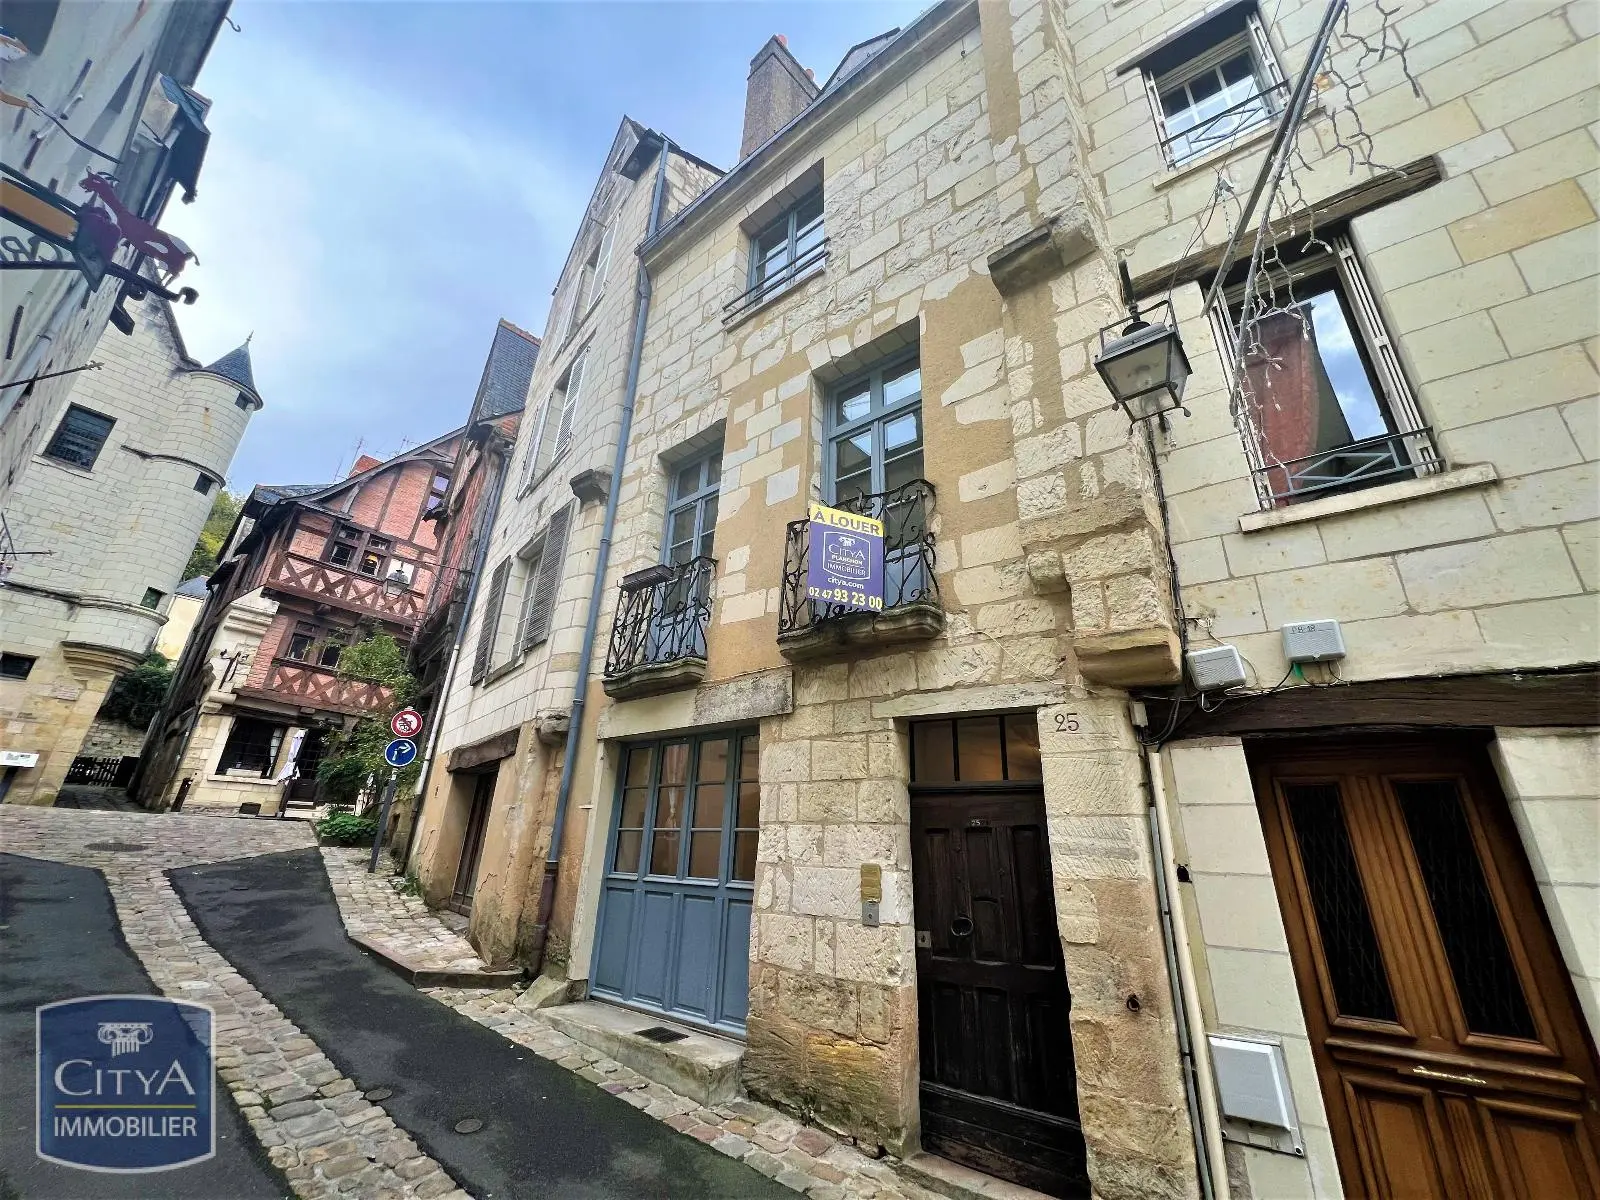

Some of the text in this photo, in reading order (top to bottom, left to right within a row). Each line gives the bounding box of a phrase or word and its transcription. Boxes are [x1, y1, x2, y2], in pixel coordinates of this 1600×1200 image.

[830, 514, 880, 535] LOUER
[828, 544, 866, 560] CITYA
[831, 555, 863, 565] PLANCHON
[827, 563, 866, 576] IMMOBILIER
[827, 576, 864, 590] citya.com
[808, 586, 883, 610] 02 47 93 23 00
[1054, 712, 1080, 732] 25
